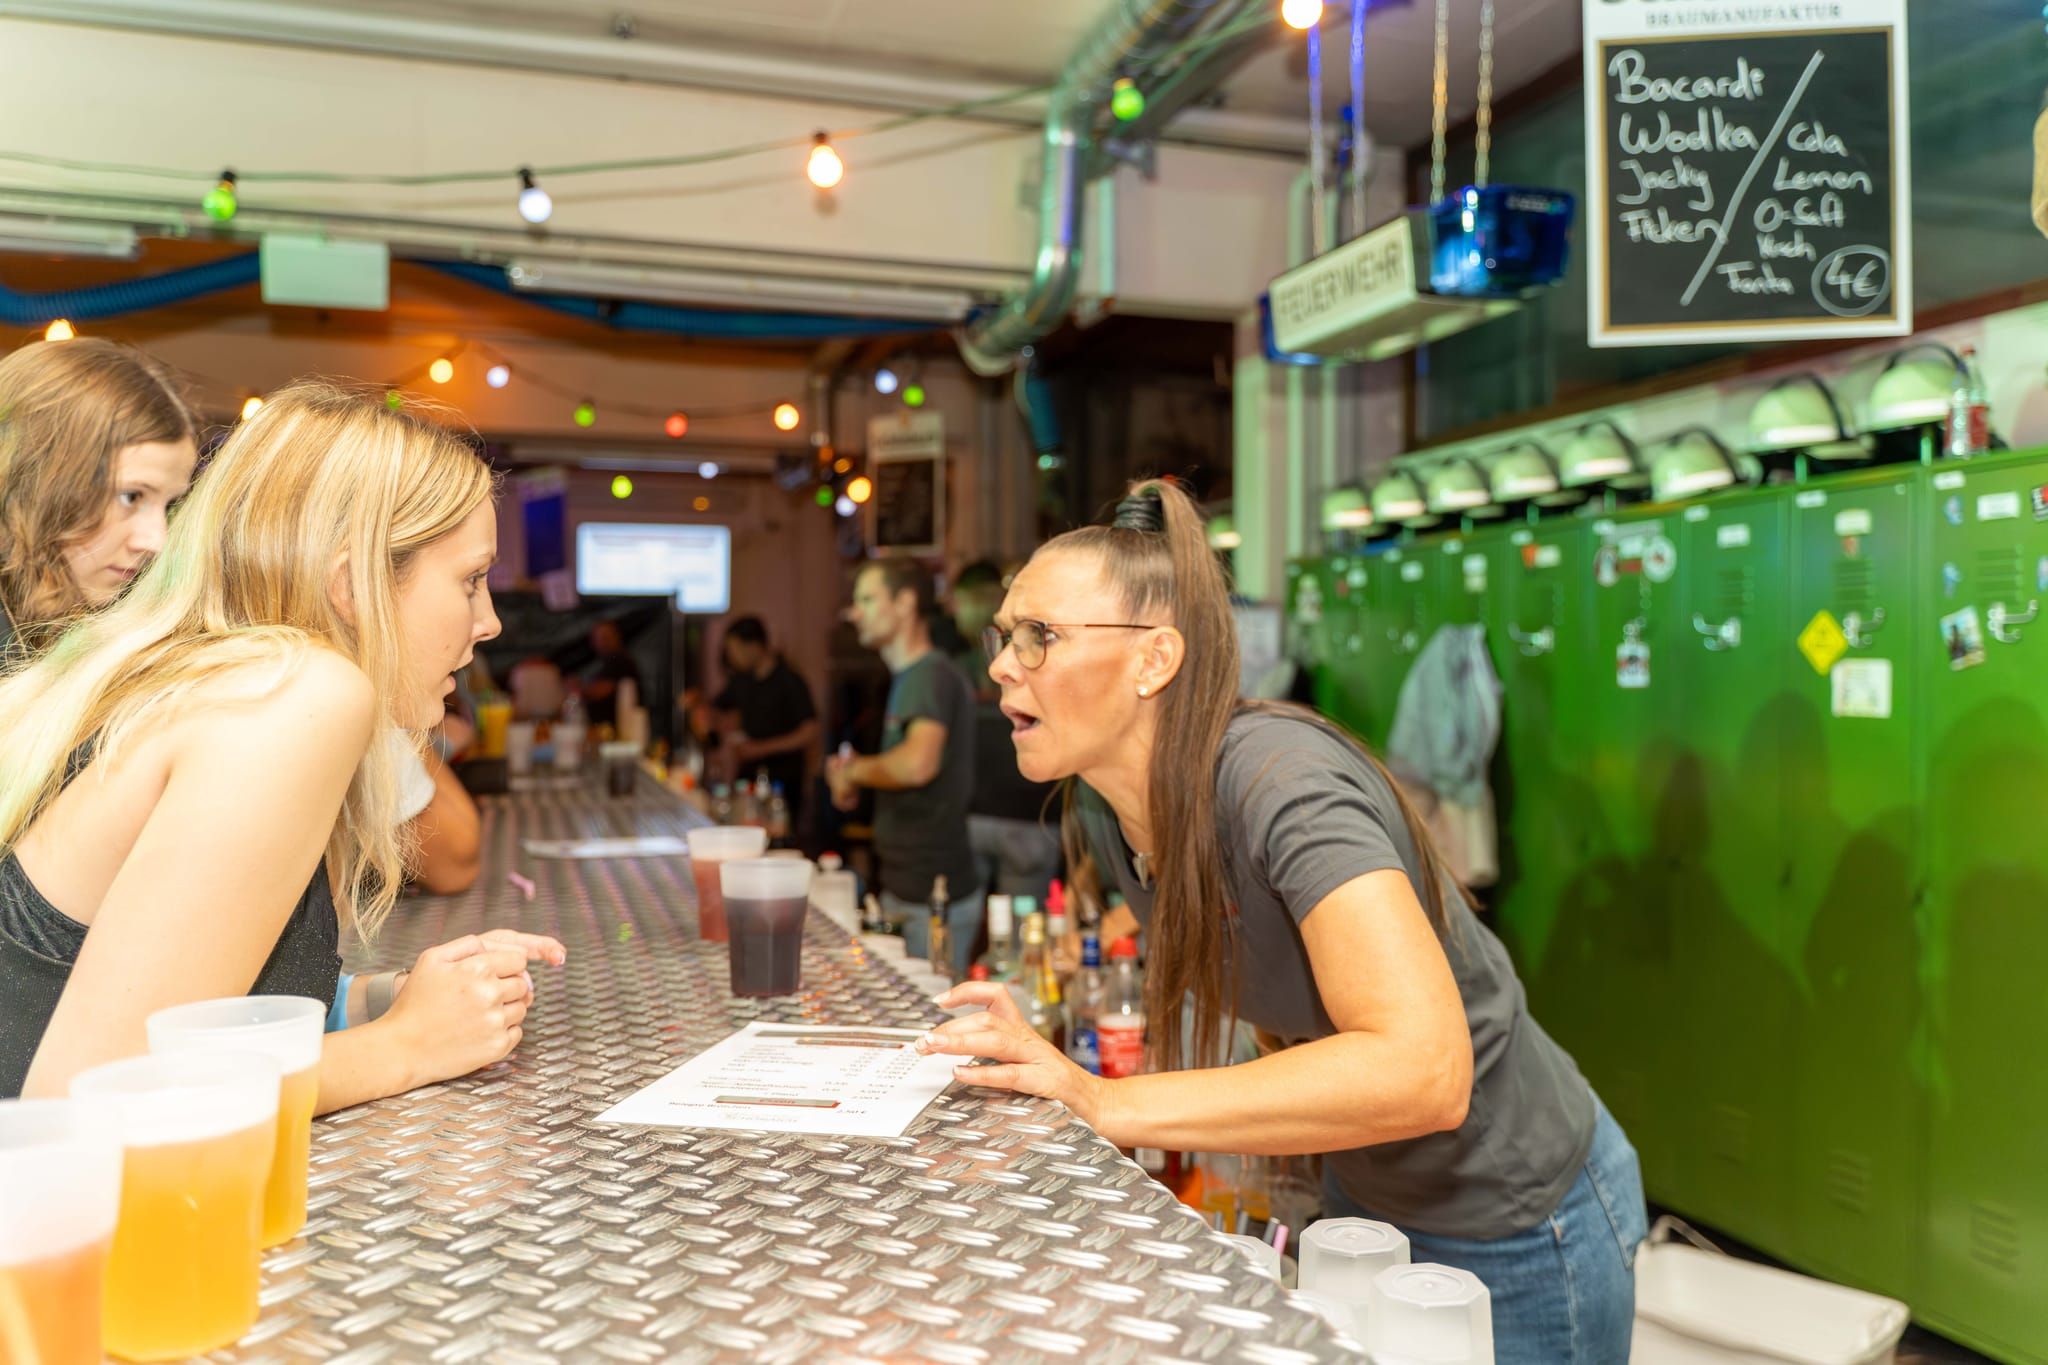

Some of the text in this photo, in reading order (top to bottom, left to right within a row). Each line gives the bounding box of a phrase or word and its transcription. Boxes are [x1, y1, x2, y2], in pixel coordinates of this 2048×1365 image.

[1646, 4, 1841, 27] BRAUMANUFAKTUR
[1608, 49, 1765, 104] Bacardi
[1619, 106, 1760, 154] Wodka
[1773, 156, 1873, 195] Lemon
[1277, 242, 1399, 322] FEUERWEHR
[1825, 254, 1883, 300] 4€
